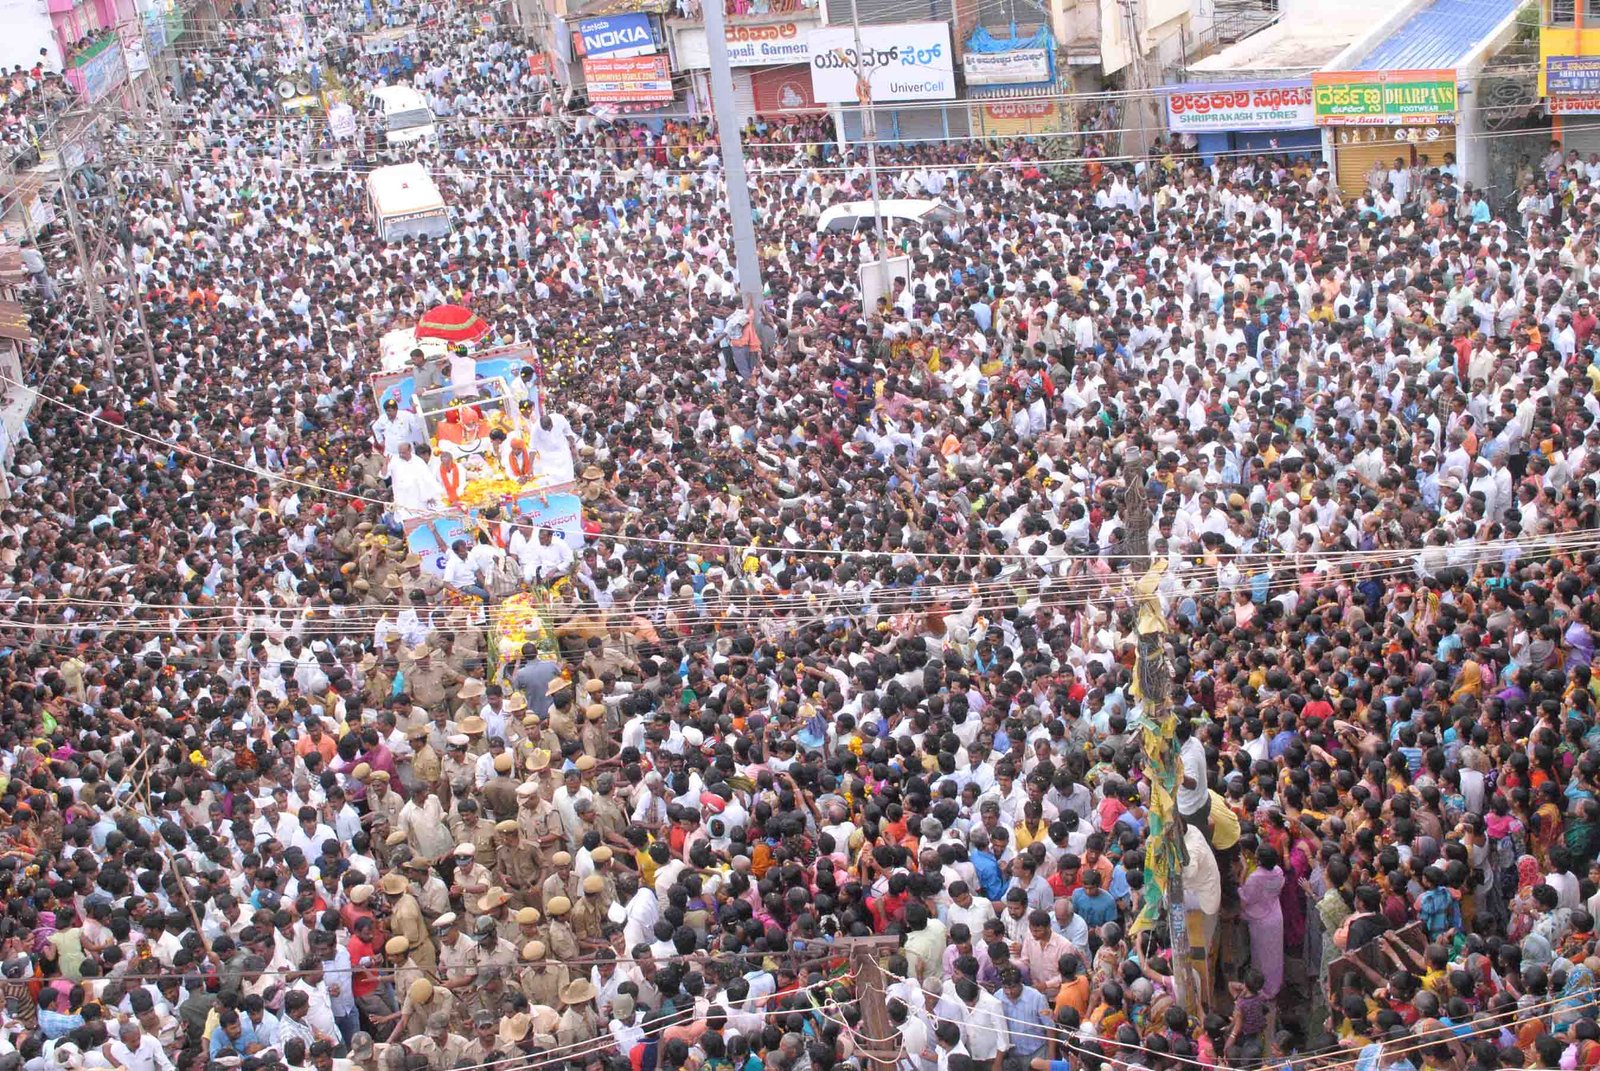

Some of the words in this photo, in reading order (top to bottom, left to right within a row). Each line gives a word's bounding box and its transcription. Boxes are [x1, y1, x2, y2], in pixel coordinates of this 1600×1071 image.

[584, 26, 649, 49] NOKIA
[761, 43, 808, 56] Garmen
[1576, 70, 1600, 78] SHANT
[890, 81, 944, 93] UniverCell
[1385, 87, 1453, 104] DHARPANS
[1399, 105, 1439, 113] FOOTWEAR
[1180, 111, 1253, 123] SHRIPRAKASH
[1256, 110, 1298, 120] STORES
